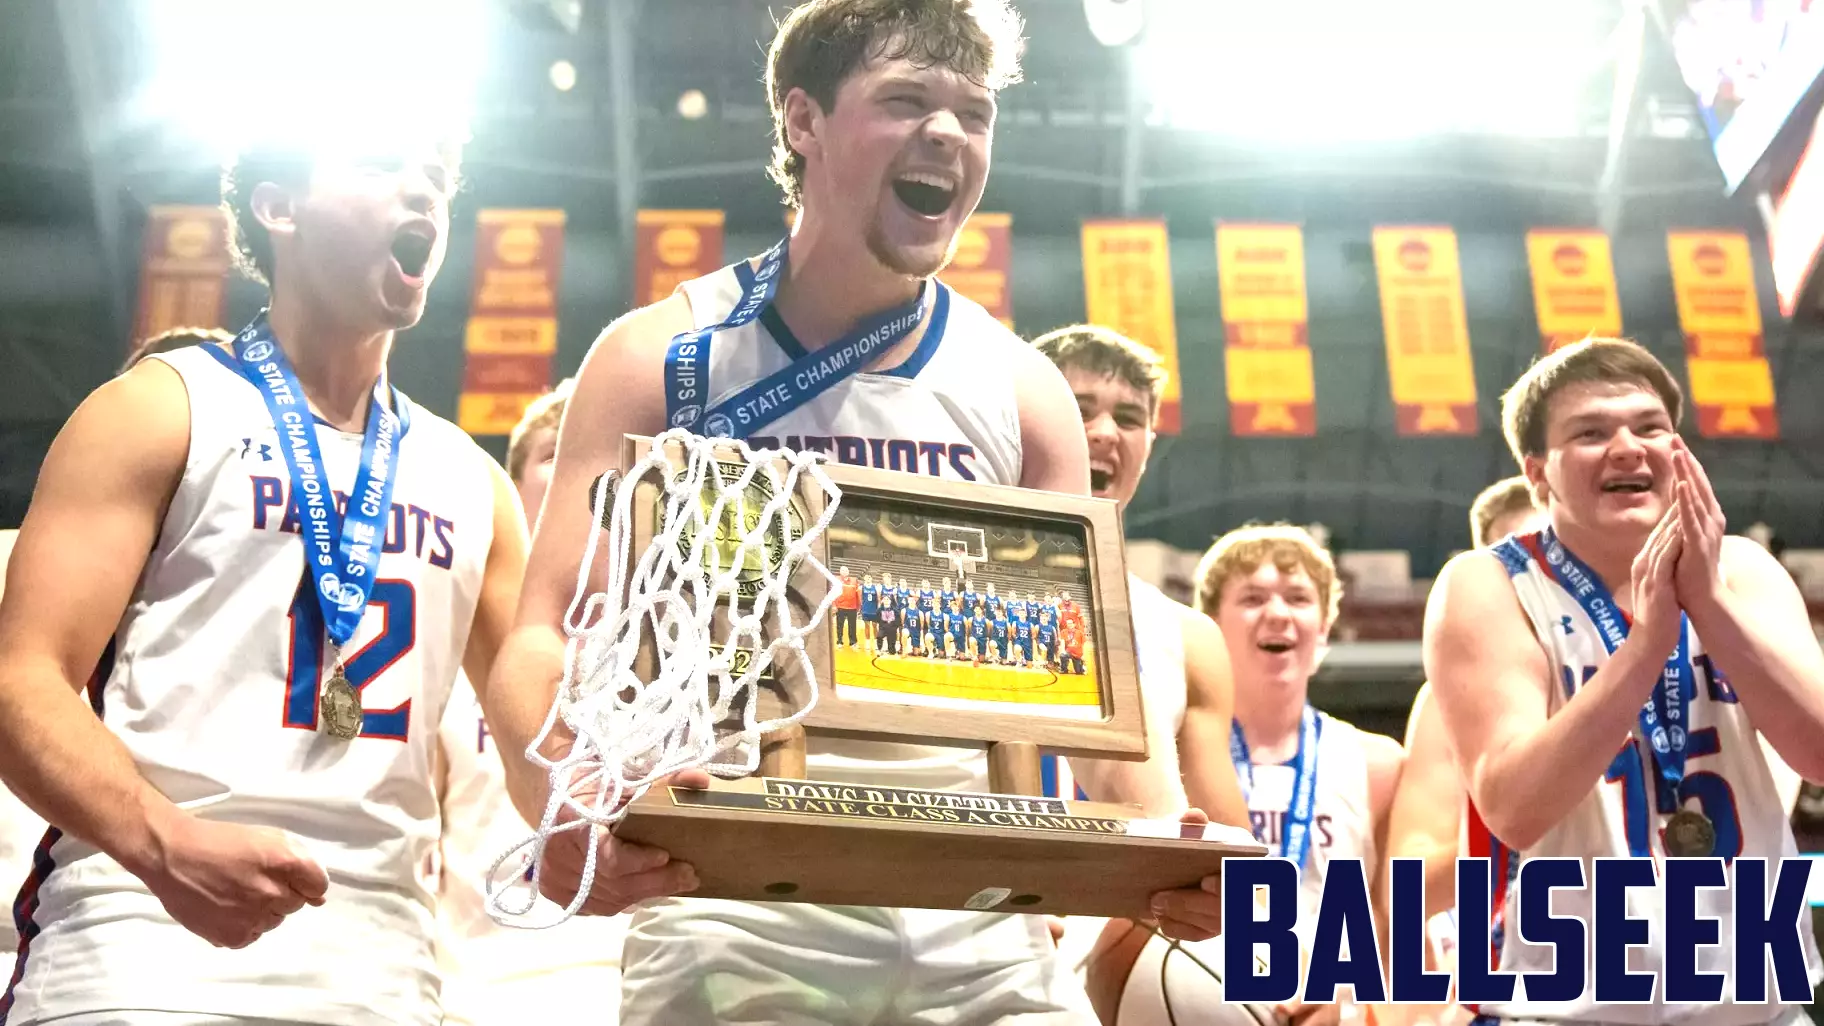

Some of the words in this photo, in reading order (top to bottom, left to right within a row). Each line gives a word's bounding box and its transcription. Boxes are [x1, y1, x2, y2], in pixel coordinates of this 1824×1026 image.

[743, 283, 769, 320] STATE
[736, 383, 793, 426] STATE
[795, 311, 922, 391] CHAMPIONSHIPS
[258, 362, 296, 406] STATE
[282, 412, 333, 567] CHAMPIONSHIPS
[747, 435, 977, 482] RIOTS
[249, 475, 455, 571] PAOTS
[346, 521, 376, 578] STATE
[1561, 560, 1596, 597] STATE
[282, 578, 418, 743] 12
[1663, 667, 1681, 721] STATE
[764, 796, 860, 815] STATE
[866, 803, 960, 822] CLASS
[967, 811, 987, 824] A
[1605, 734, 1744, 868] 15
